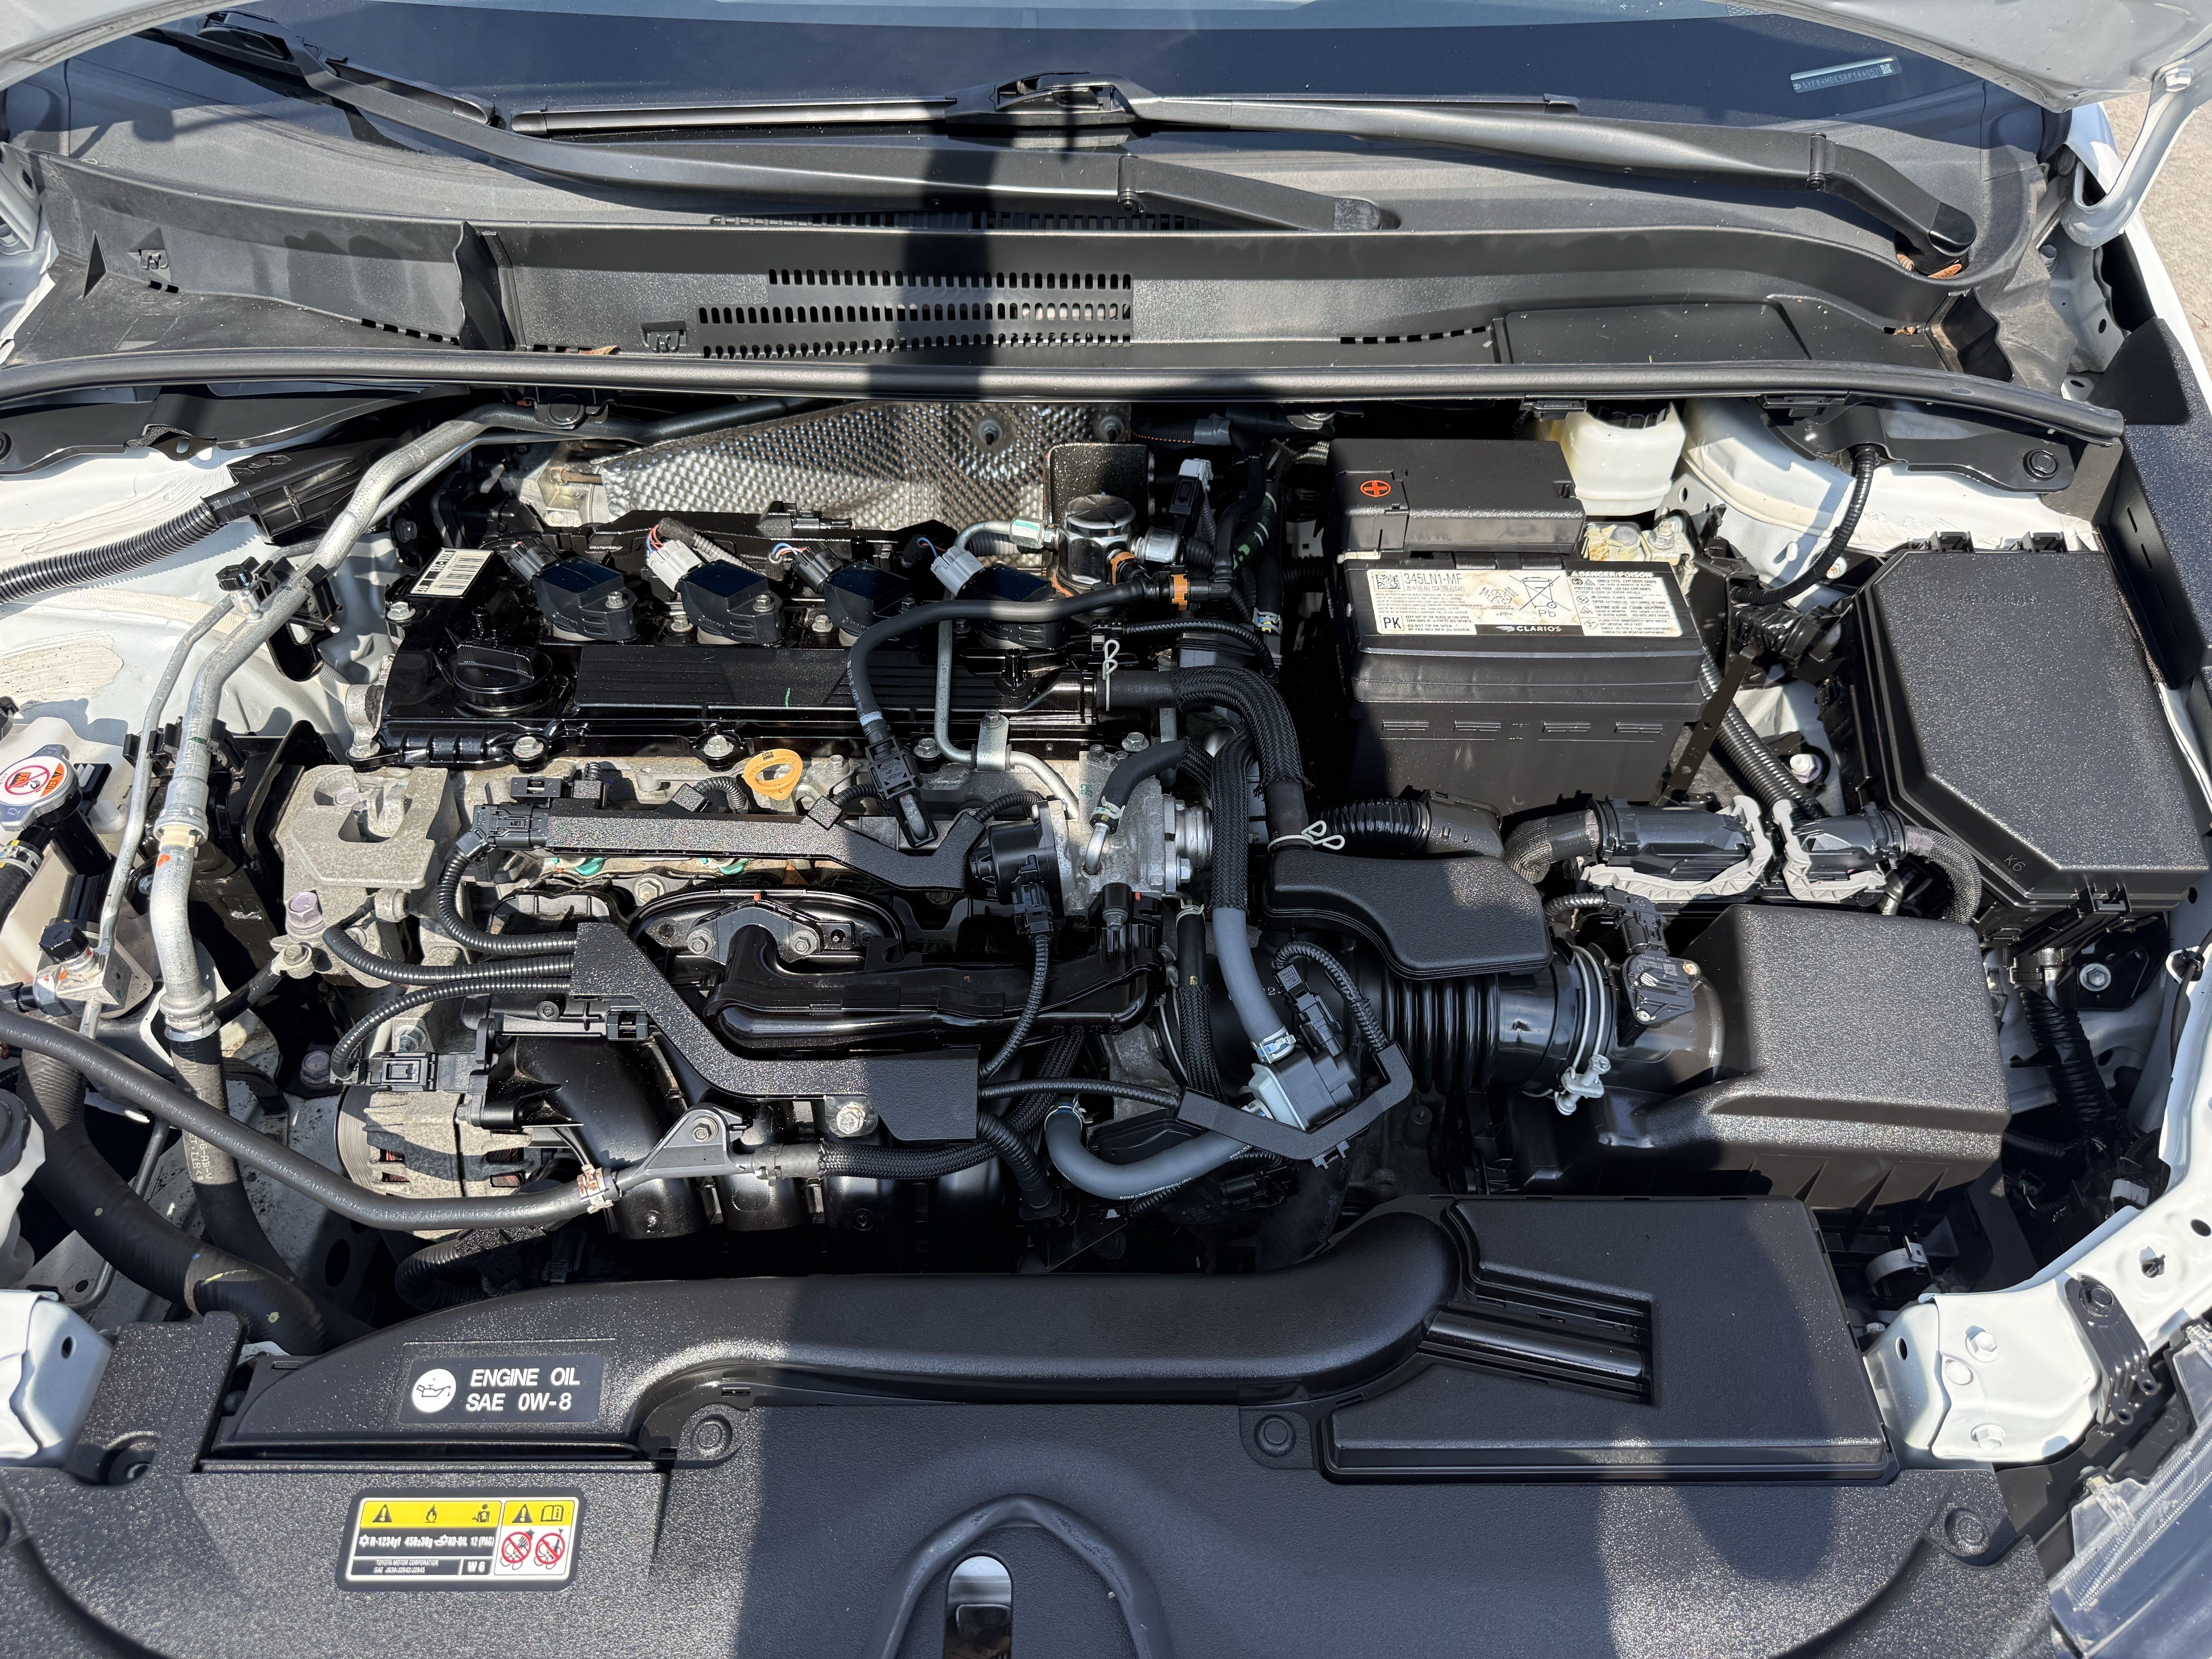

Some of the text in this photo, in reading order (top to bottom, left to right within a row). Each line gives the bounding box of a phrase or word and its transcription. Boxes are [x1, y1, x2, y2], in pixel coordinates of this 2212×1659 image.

[1404, 573, 1462, 584] 345LN1-MF
[1384, 617, 1401, 629] PK
[2004, 854, 2025, 871] K6
[470, 1367, 580, 1387] ENGINE OIL
[465, 1392, 572, 1412] SAE 0W-8
[447, 1536, 467, 1547] ND-OIL
